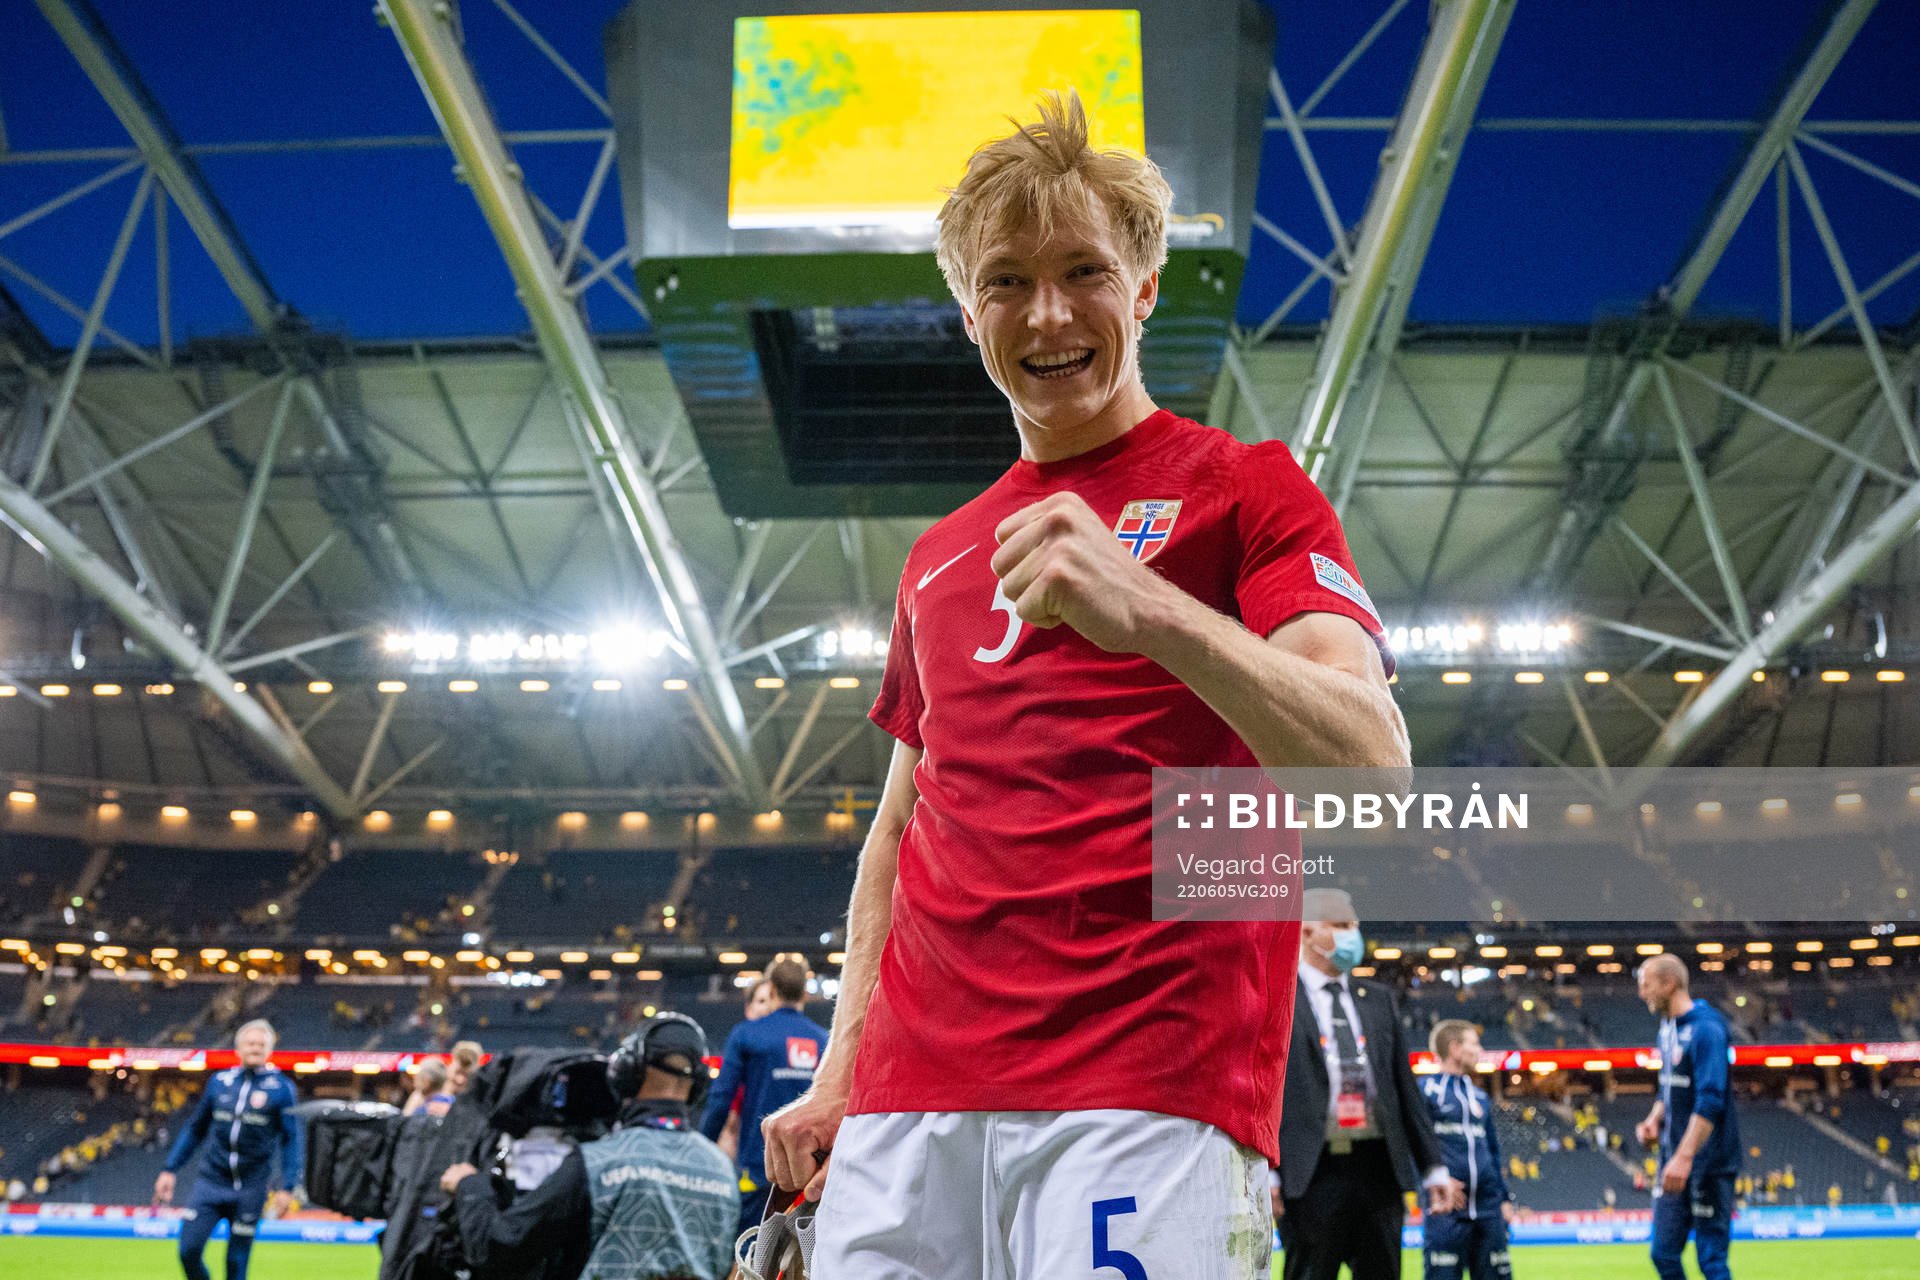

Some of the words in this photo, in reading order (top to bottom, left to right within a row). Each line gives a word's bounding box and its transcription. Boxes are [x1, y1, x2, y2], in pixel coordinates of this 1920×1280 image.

[1313, 555, 1334, 567] UEFA
[972, 577, 1024, 663] 5
[1091, 1196, 1148, 1280] 5
